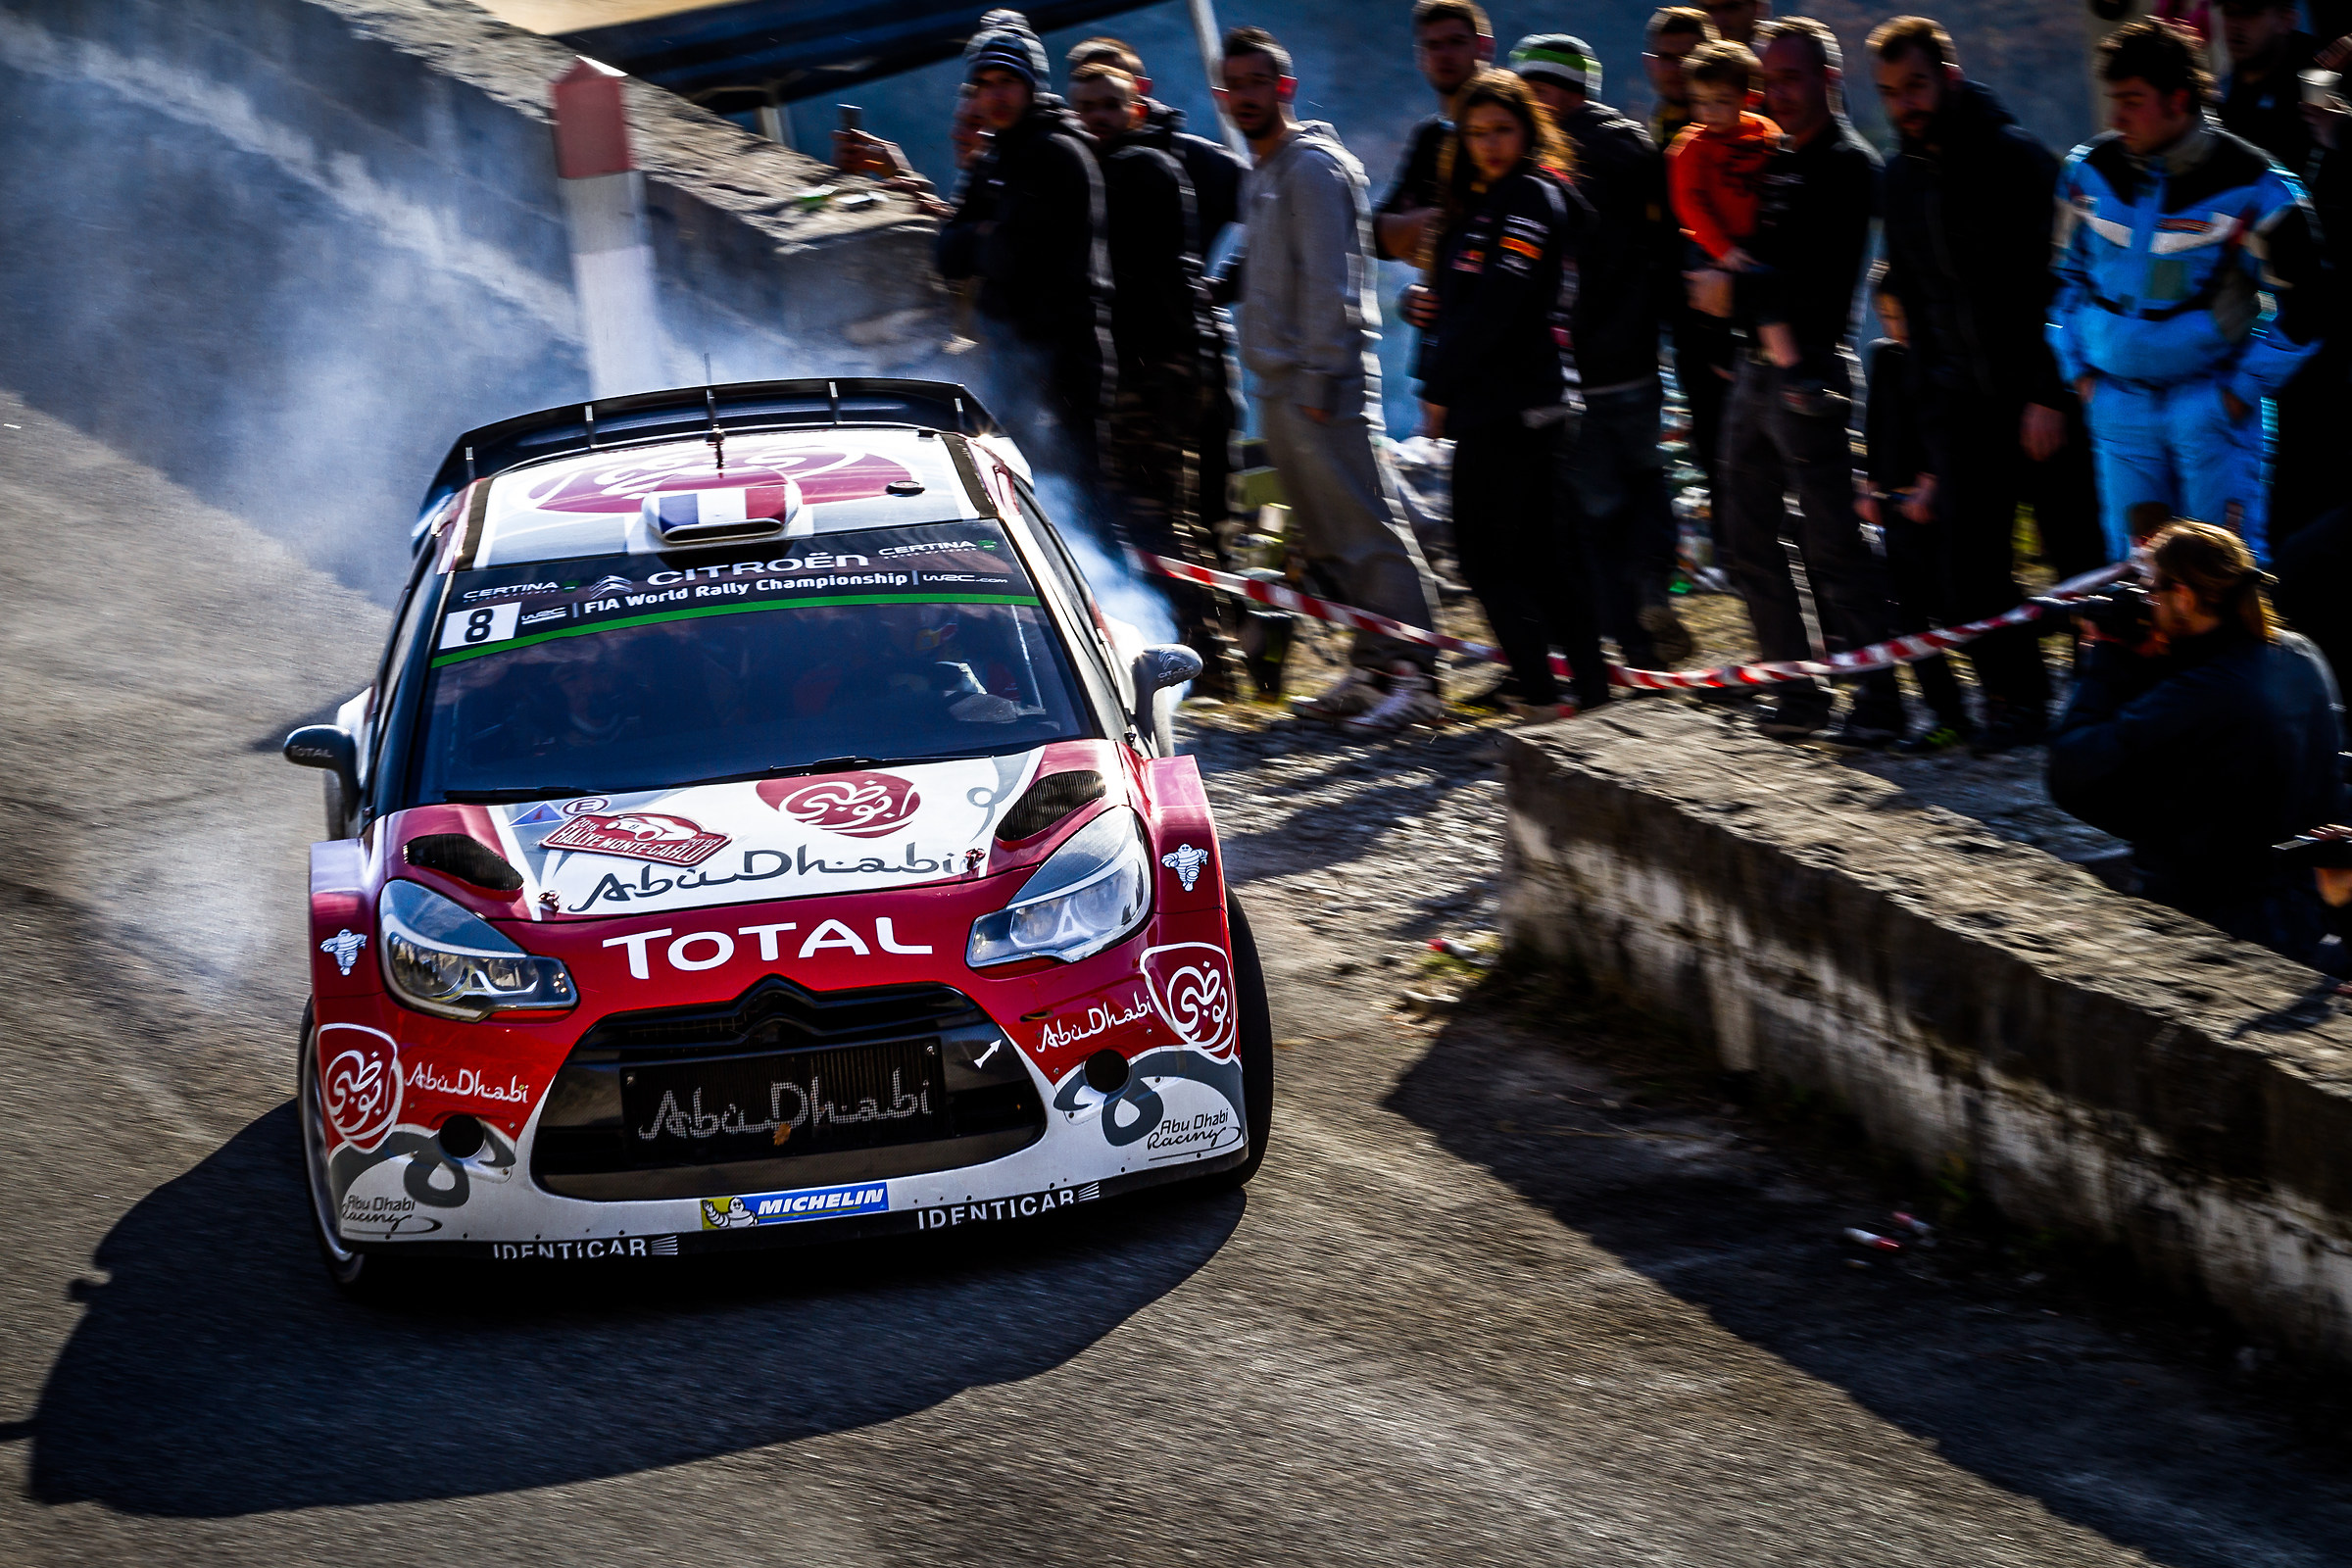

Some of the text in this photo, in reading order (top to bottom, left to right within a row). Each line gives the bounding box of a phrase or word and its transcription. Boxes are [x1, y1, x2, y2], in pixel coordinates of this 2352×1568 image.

[878, 541, 977, 557] CERTINA
[463, 581, 560, 600] CERTINA
[584, 572, 907, 614] FIA World Rally Championship
[465, 608, 494, 643] 8
[521, 607, 567, 624] WRC
[290, 745, 334, 759] TOTAL
[576, 817, 599, 831] 2016
[550, 825, 713, 862] RALLYE MONTE-CARLO
[602, 916, 933, 980] TOTAL
[1160, 1107, 1229, 1136] Abu Dhabi
[1147, 1126, 1227, 1151] Racing
[345, 1194, 416, 1211] Abu Dhabi
[758, 1188, 885, 1216] MICHELIN
[917, 1189, 1075, 1230] IDENTICAR
[493, 1238, 647, 1260] IDENTICAR
